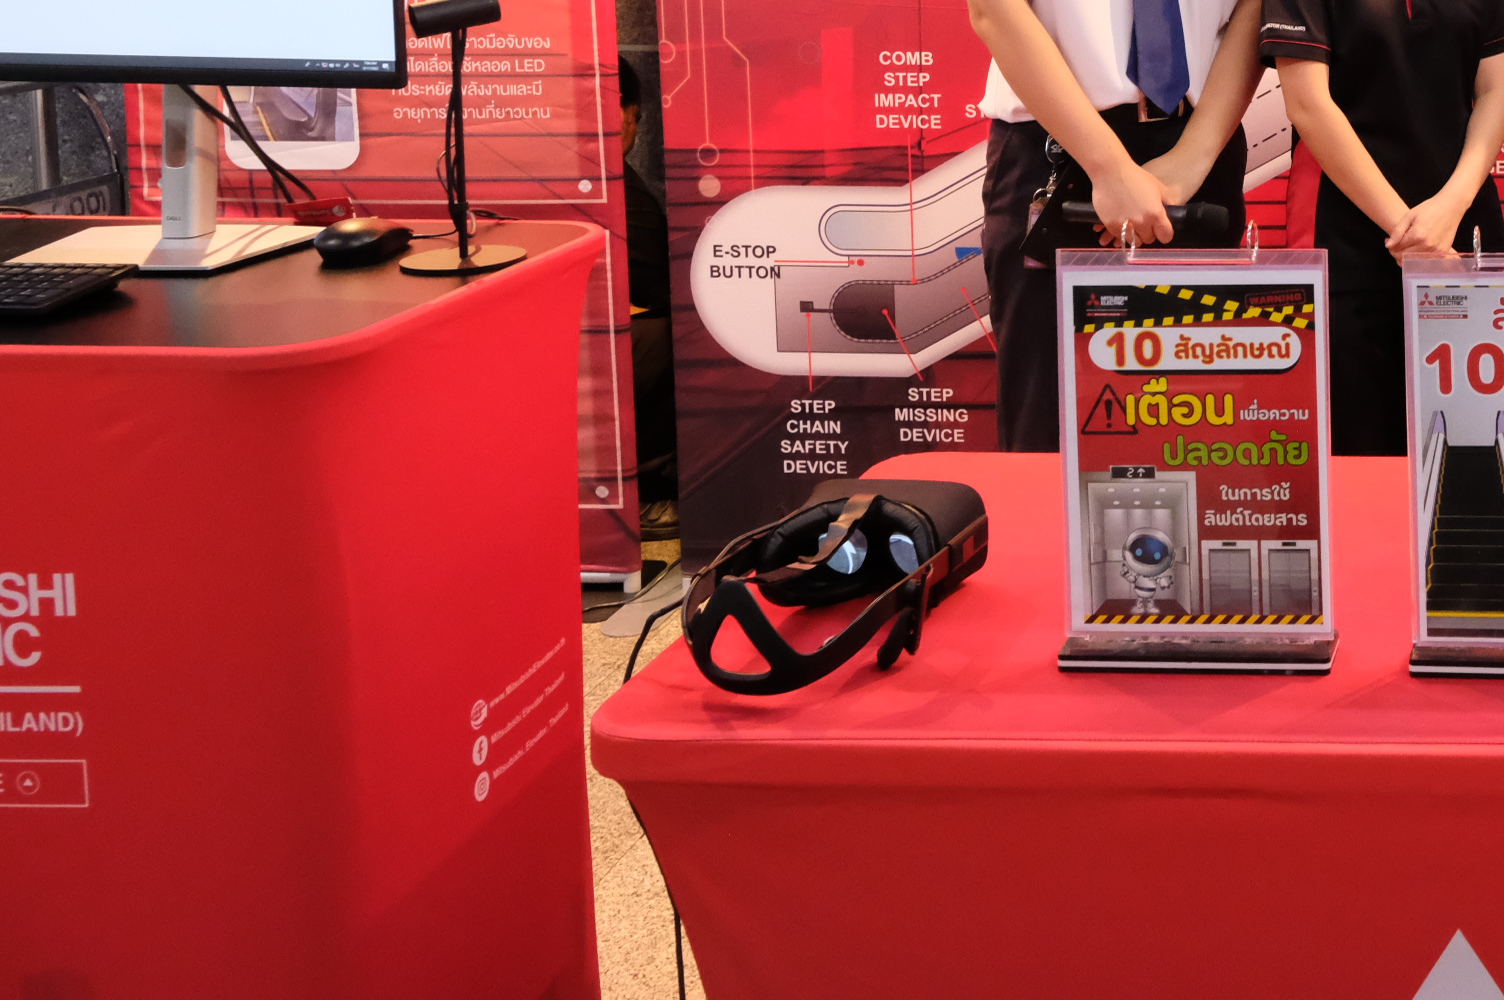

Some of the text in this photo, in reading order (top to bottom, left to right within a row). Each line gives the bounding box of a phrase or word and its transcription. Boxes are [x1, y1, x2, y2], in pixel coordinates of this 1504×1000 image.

[515, 60, 545, 72] LED
[879, 51, 934, 66] COMB
[884, 72, 930, 87] STEP
[874, 93, 941, 108] IMPACT
[875, 114, 942, 129] DEVICE
[713, 244, 777, 259] E-STOP
[709, 265, 781, 280] BUTTON
[1249, 292, 1302, 305] WARNING
[1106, 330, 1292, 368] 10 สัญลักษณ์
[907, 388, 953, 402] STEP
[1125, 376, 1309, 426] เตือน เพื่อความ
[790, 400, 835, 415] STEP
[894, 408, 969, 423] MISSING
[786, 420, 841, 435] CHAIN
[899, 429, 965, 444] DEVICE
[780, 440, 849, 455] SAFETY
[1163, 430, 1309, 466] ปลอดภัย
[783, 460, 848, 475] DEVICE
[1220, 482, 1290, 501] ในการใช้
[1204, 507, 1308, 526] ลิฟต์โดยสาร
[0, 572, 76, 617] SHI
[0, 711, 83, 737] ILAND)
